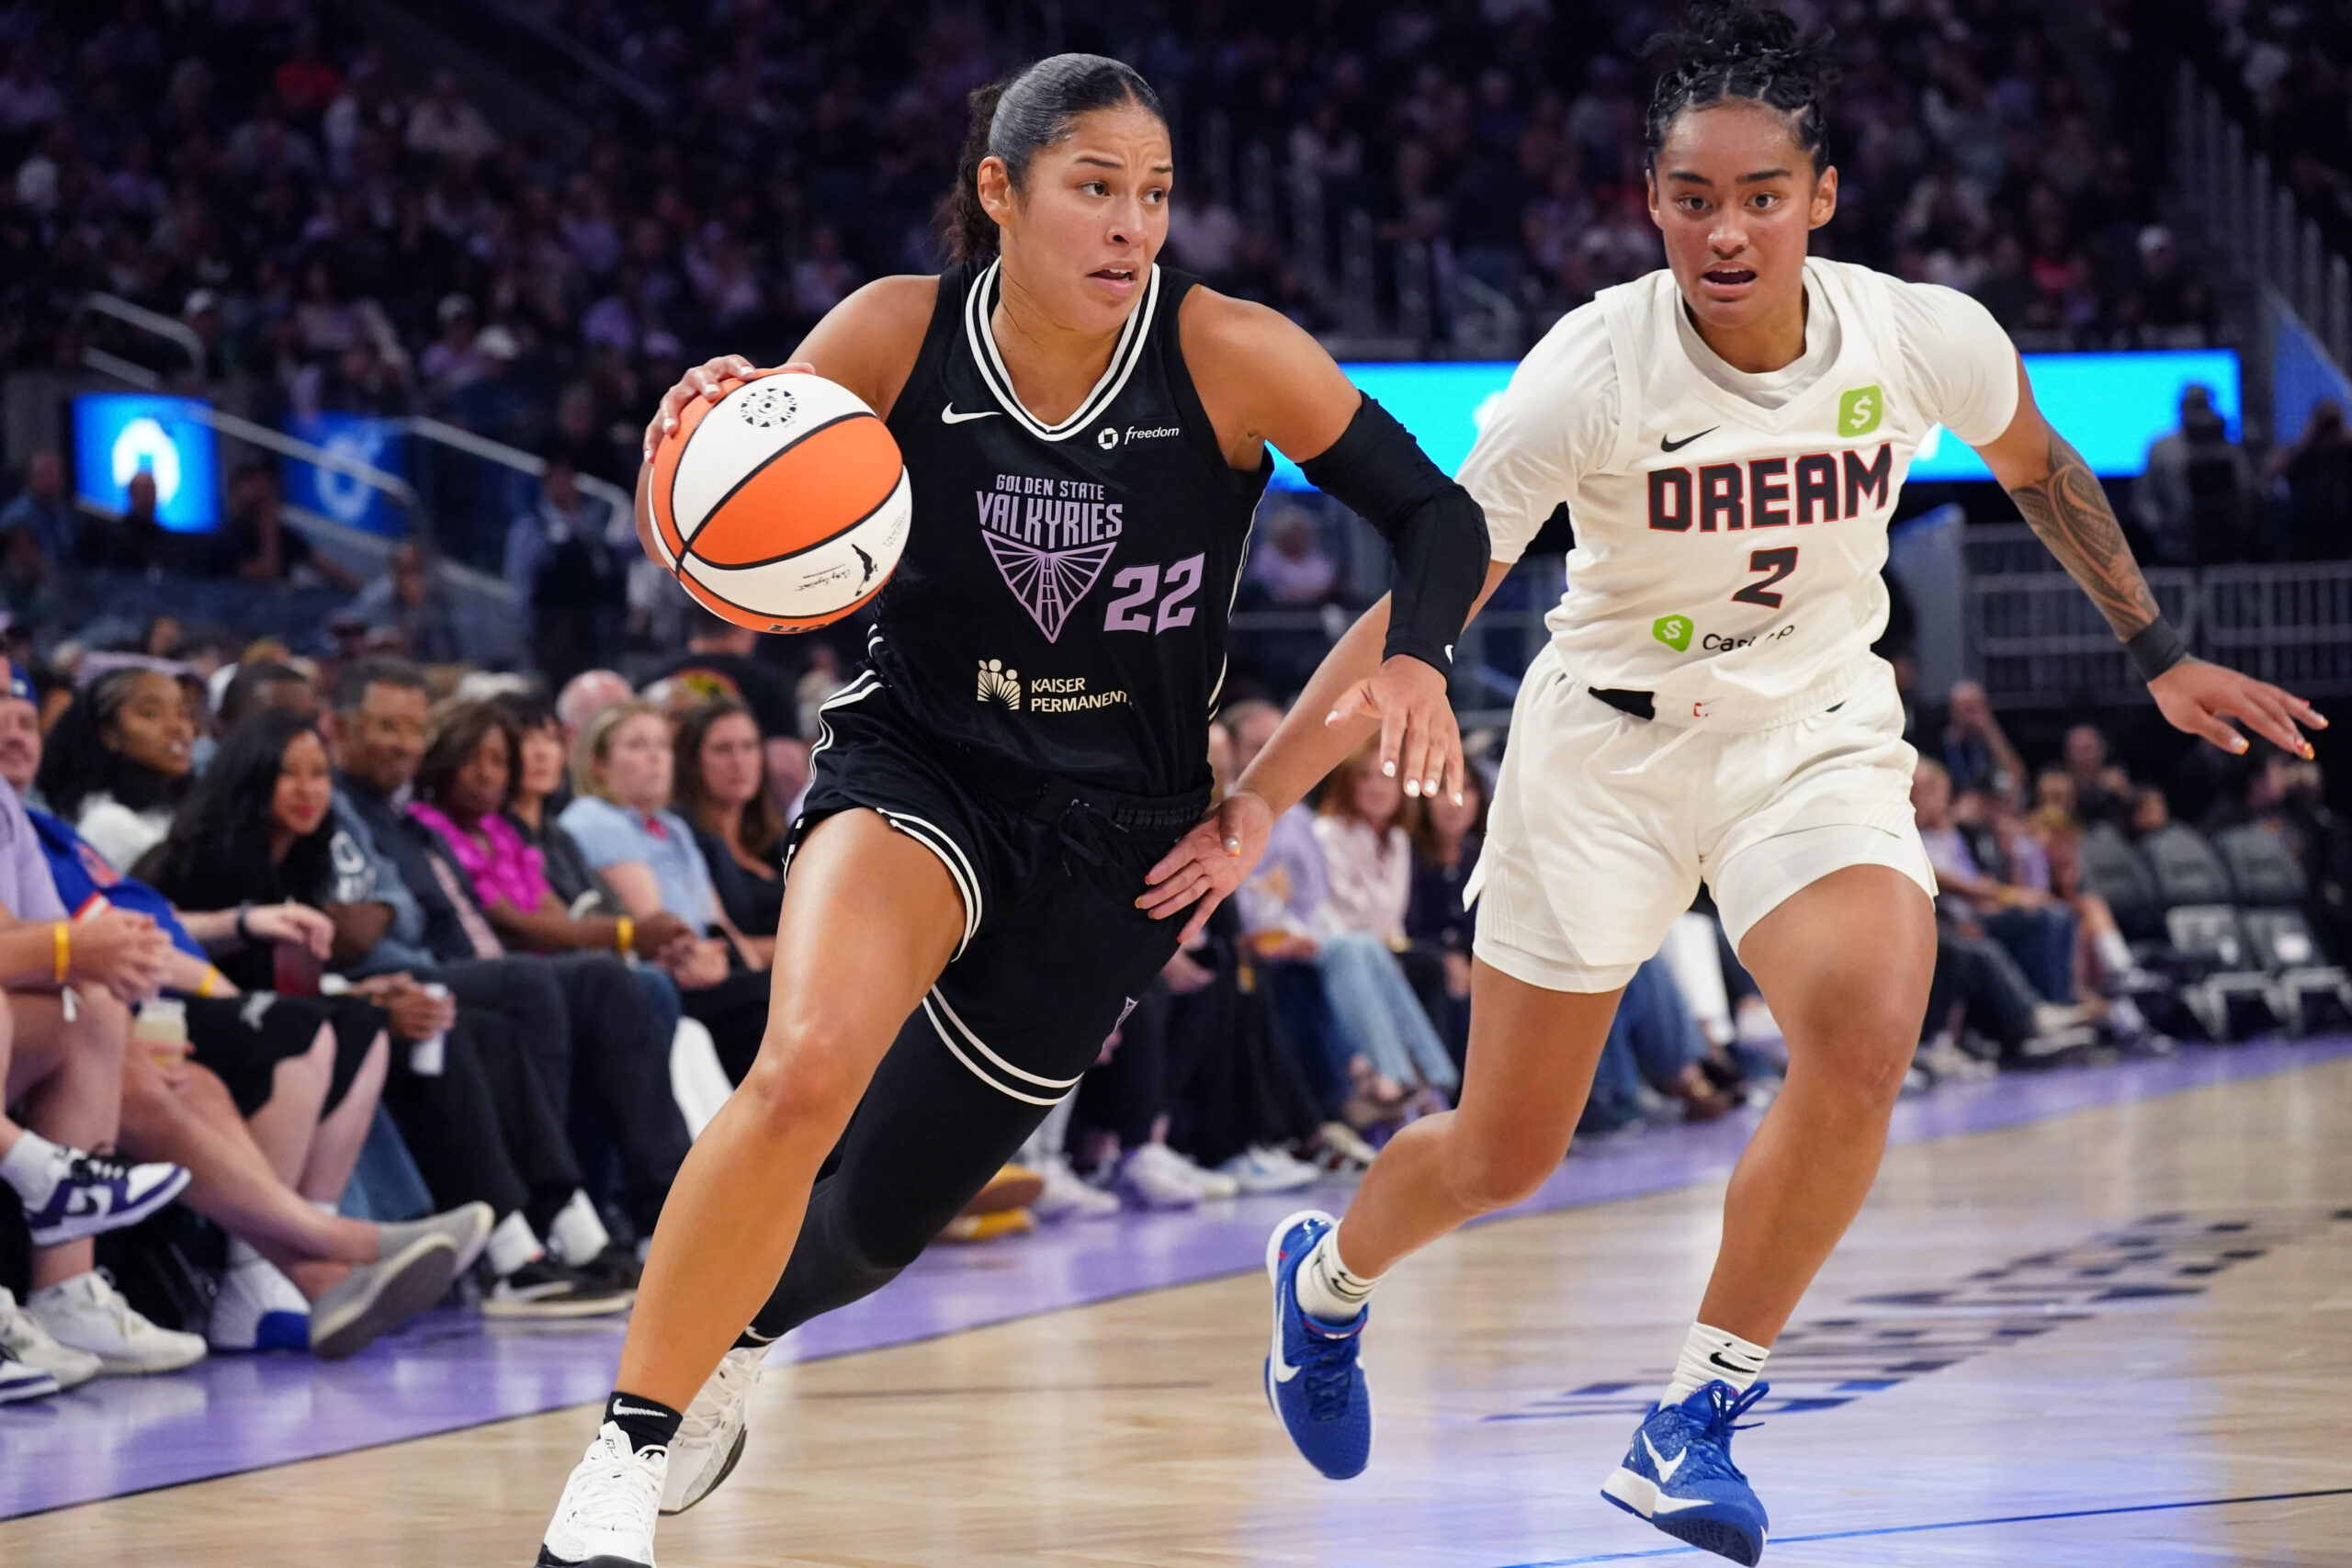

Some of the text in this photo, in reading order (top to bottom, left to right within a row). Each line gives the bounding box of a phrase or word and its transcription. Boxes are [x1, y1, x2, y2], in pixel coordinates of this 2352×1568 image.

[1124, 425, 1180, 445] freedom
[996, 474, 1104, 500] GOLDEN STATE
[1647, 442, 1893, 533] DREAM
[976, 491, 1123, 549] VALKYRIES
[1102, 552, 1205, 636] 22
[1731, 546, 1799, 609] 2
[1031, 677, 1085, 694] KAISER
[1031, 690, 1128, 713] PERMANENT
